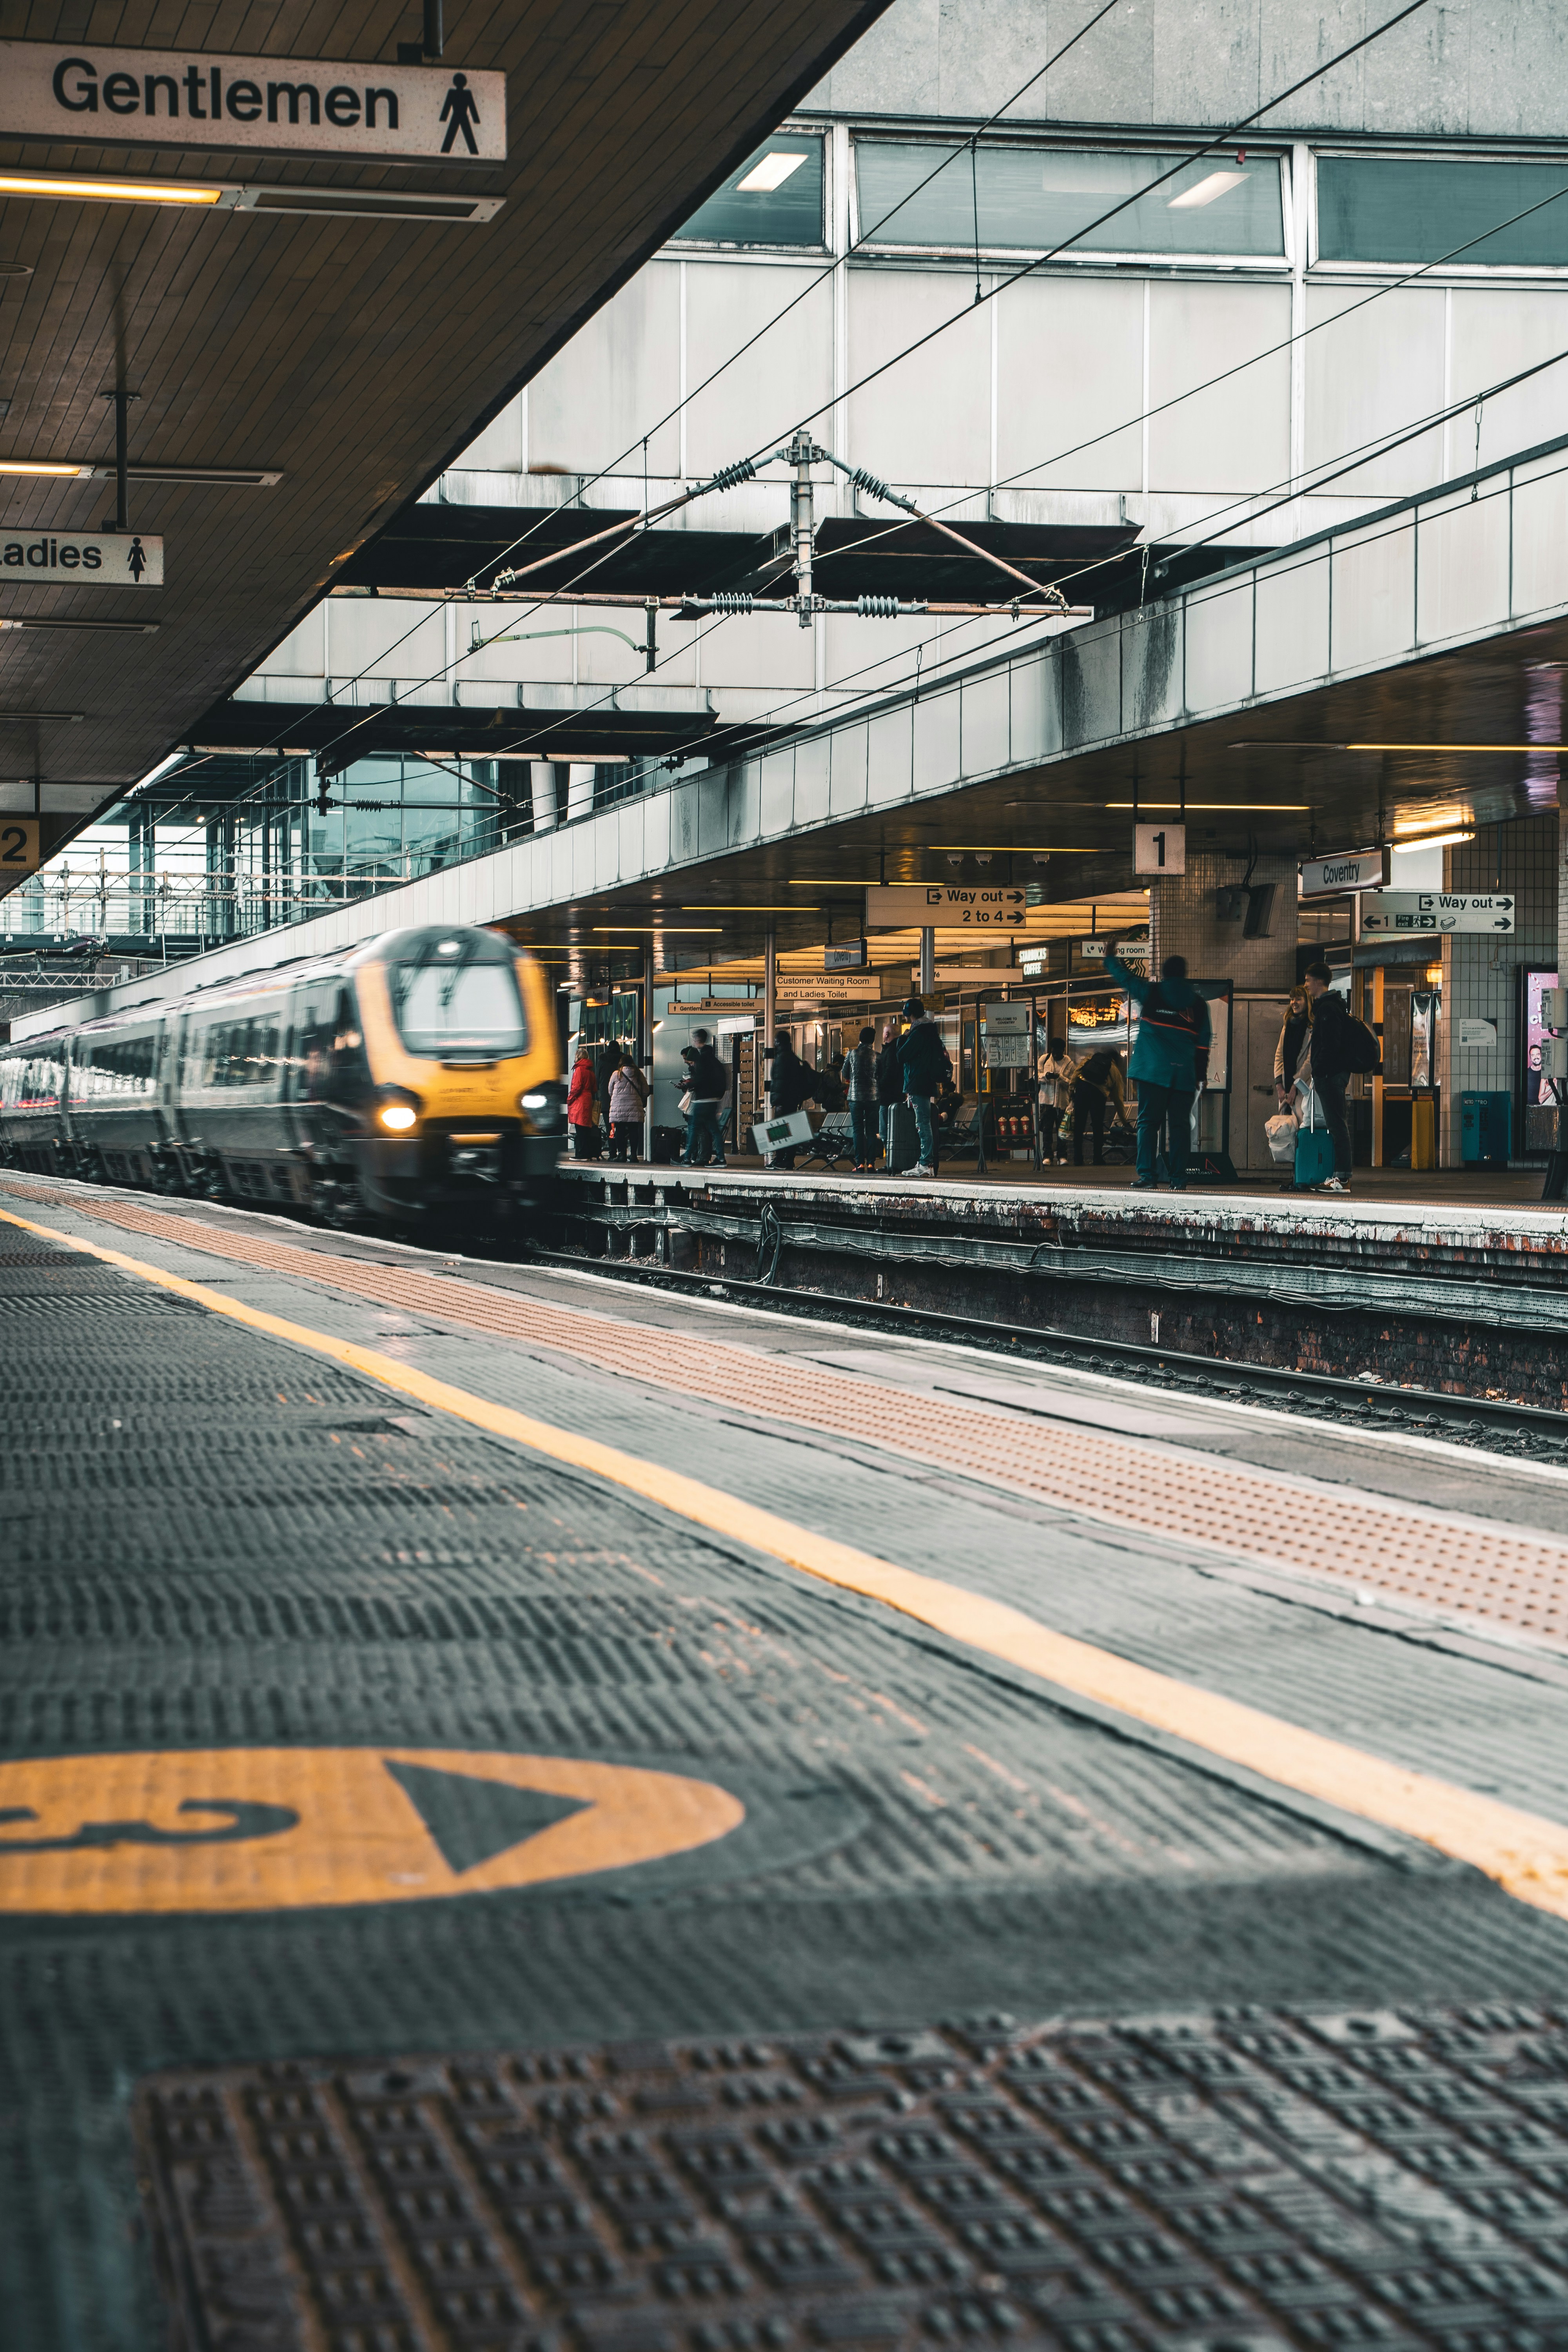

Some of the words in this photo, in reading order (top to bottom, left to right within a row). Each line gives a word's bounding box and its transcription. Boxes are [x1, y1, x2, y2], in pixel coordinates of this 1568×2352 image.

[52, 58, 399, 130] Gentlemen
[0, 538, 102, 569] adies
[2, 826, 27, 862] 2
[1153, 832, 1165, 866] 1
[1323, 860, 1359, 884] Coventry
[947, 890, 976, 904] Way
[981, 891, 1003, 902] out
[1439, 896, 1467, 910] Way
[1472, 897, 1493, 908] out
[962, 910, 971, 922] 2
[976, 910, 989, 922] to
[994, 910, 1003, 922] 4
[1384, 915, 1388, 927] 1
[834, 947, 851, 963] Coventry
[1019, 947, 1046, 963] STARBUCKS
[1023, 962, 1042, 975] COFFEE
[816, 977, 844, 986] Waiting
